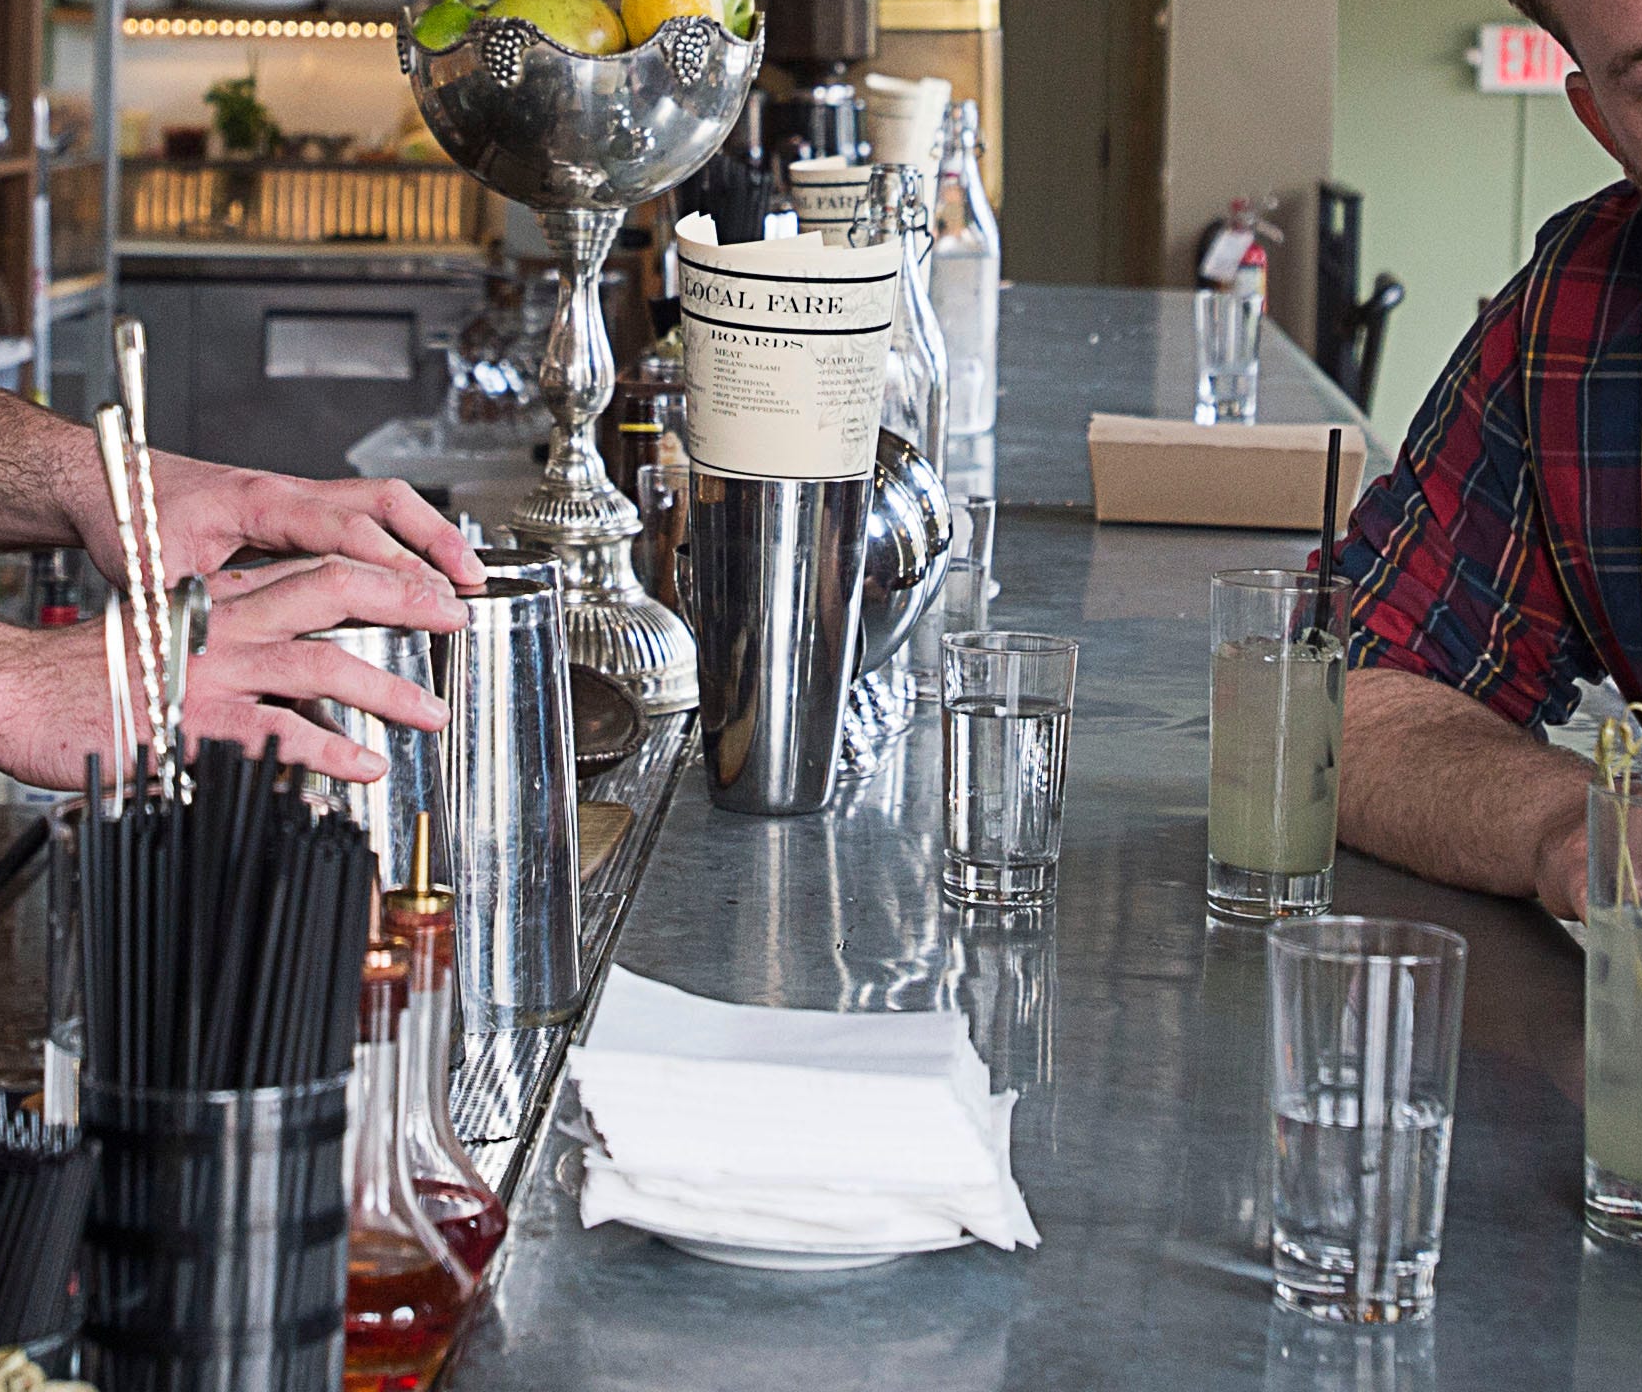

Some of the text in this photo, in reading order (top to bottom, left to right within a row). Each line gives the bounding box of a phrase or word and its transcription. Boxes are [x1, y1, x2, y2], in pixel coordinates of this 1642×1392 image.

[684, 277, 843, 314] LOCAL FARE
[711, 329, 804, 349] BOARDS
[715, 347, 743, 359] MEAT
